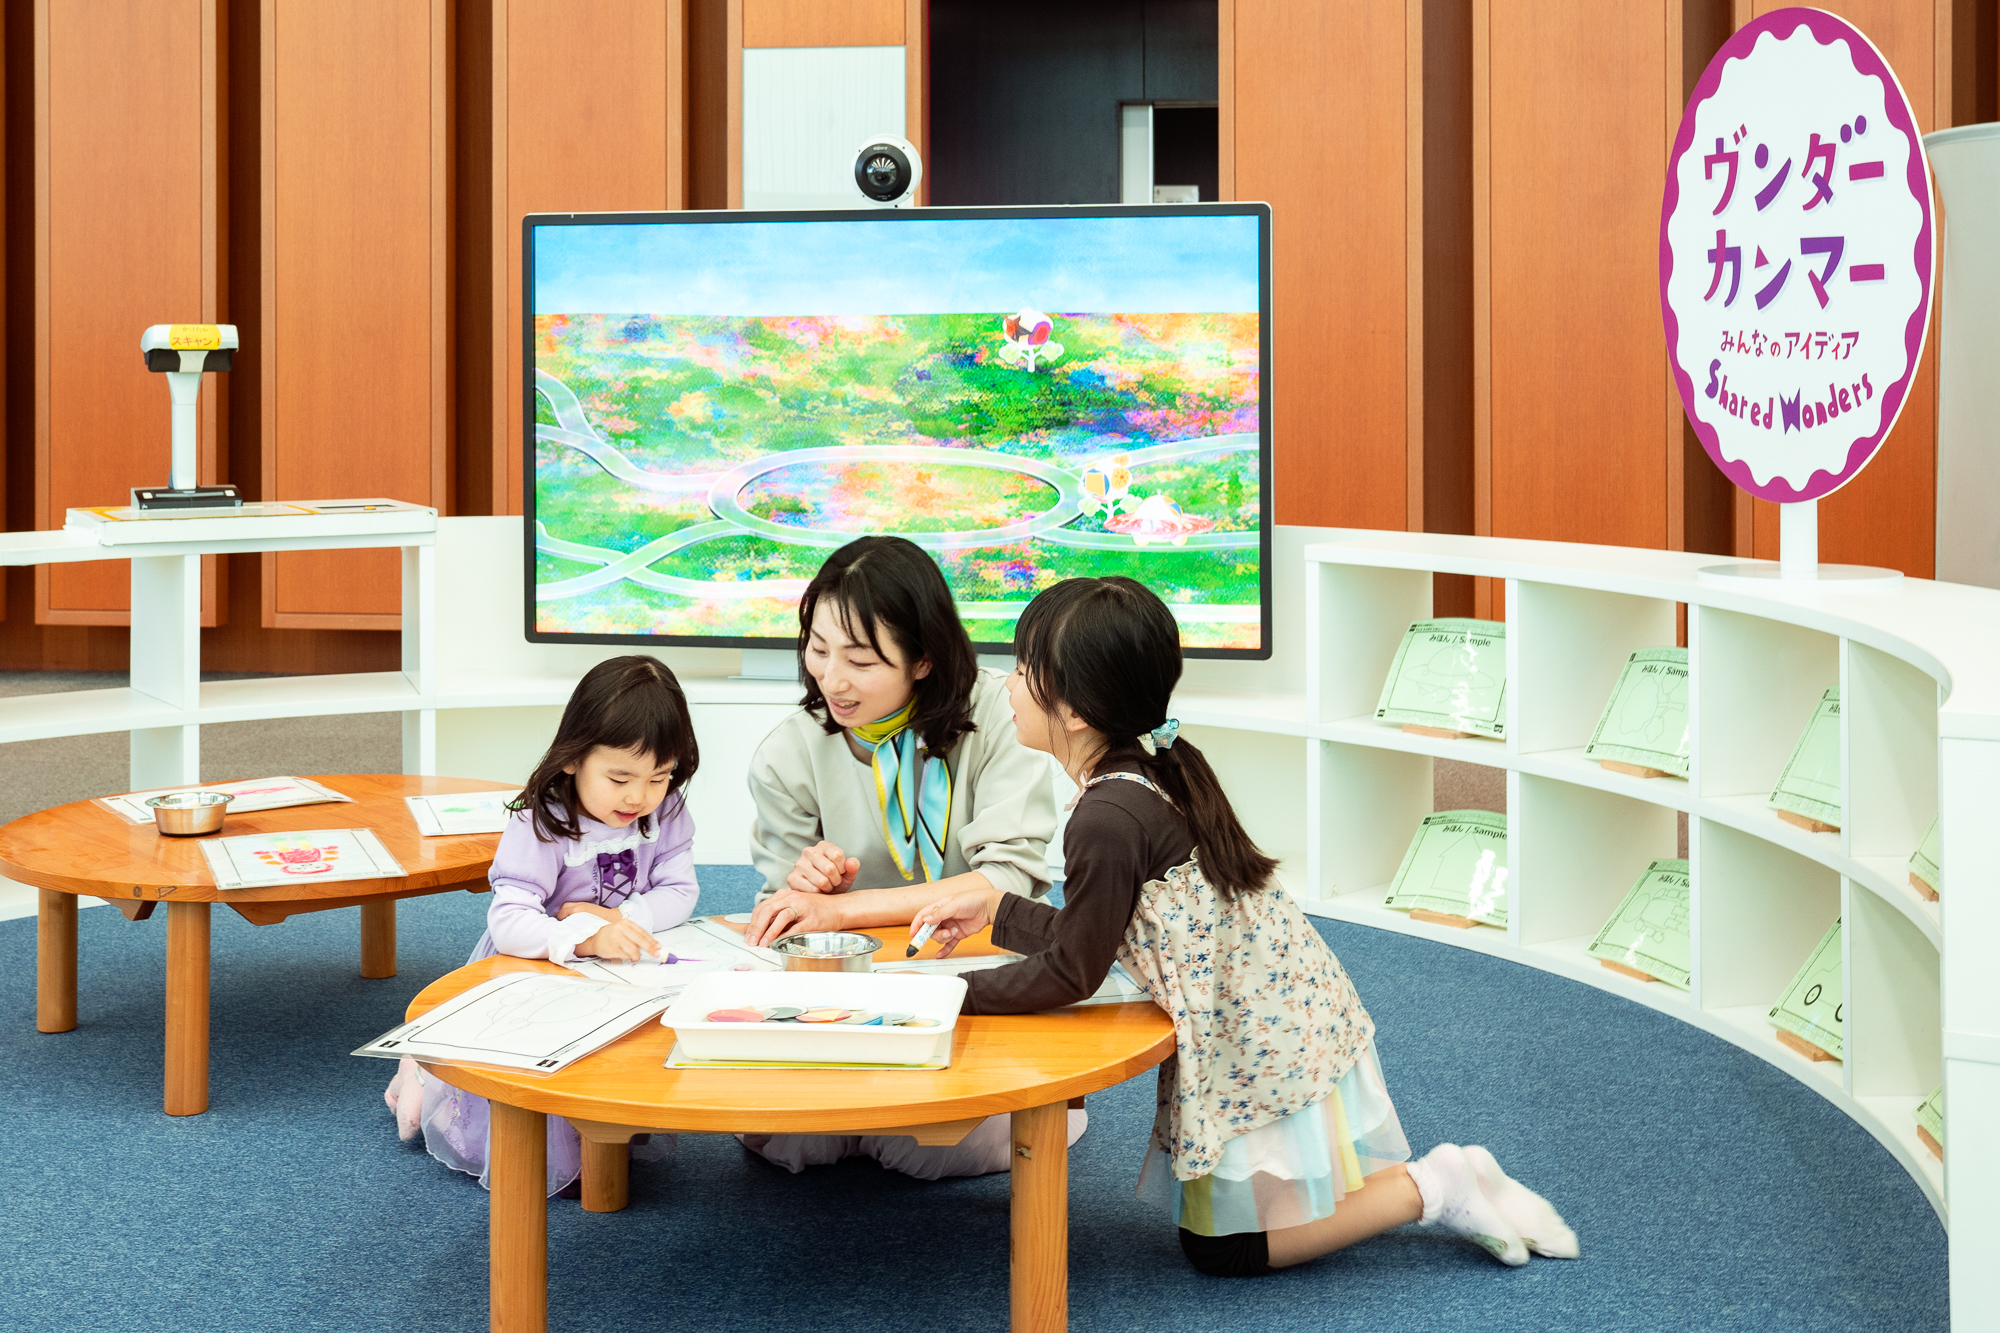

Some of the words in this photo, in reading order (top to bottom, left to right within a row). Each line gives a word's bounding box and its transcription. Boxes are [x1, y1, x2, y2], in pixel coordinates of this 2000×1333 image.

[1704, 115, 1885, 216] ヴンダー
[1703, 229, 1885, 310] カンマー
[1720, 329, 1859, 360] みんなのアイディア
[1705, 359, 1774, 430] Shared
[1779, 373, 1873, 435] Wonders
[1429, 634, 1450, 643] みほん
[1666, 666, 1688, 678] Samp
[1442, 825, 1464, 833] みほん
[1473, 826, 1507, 839] Sample
